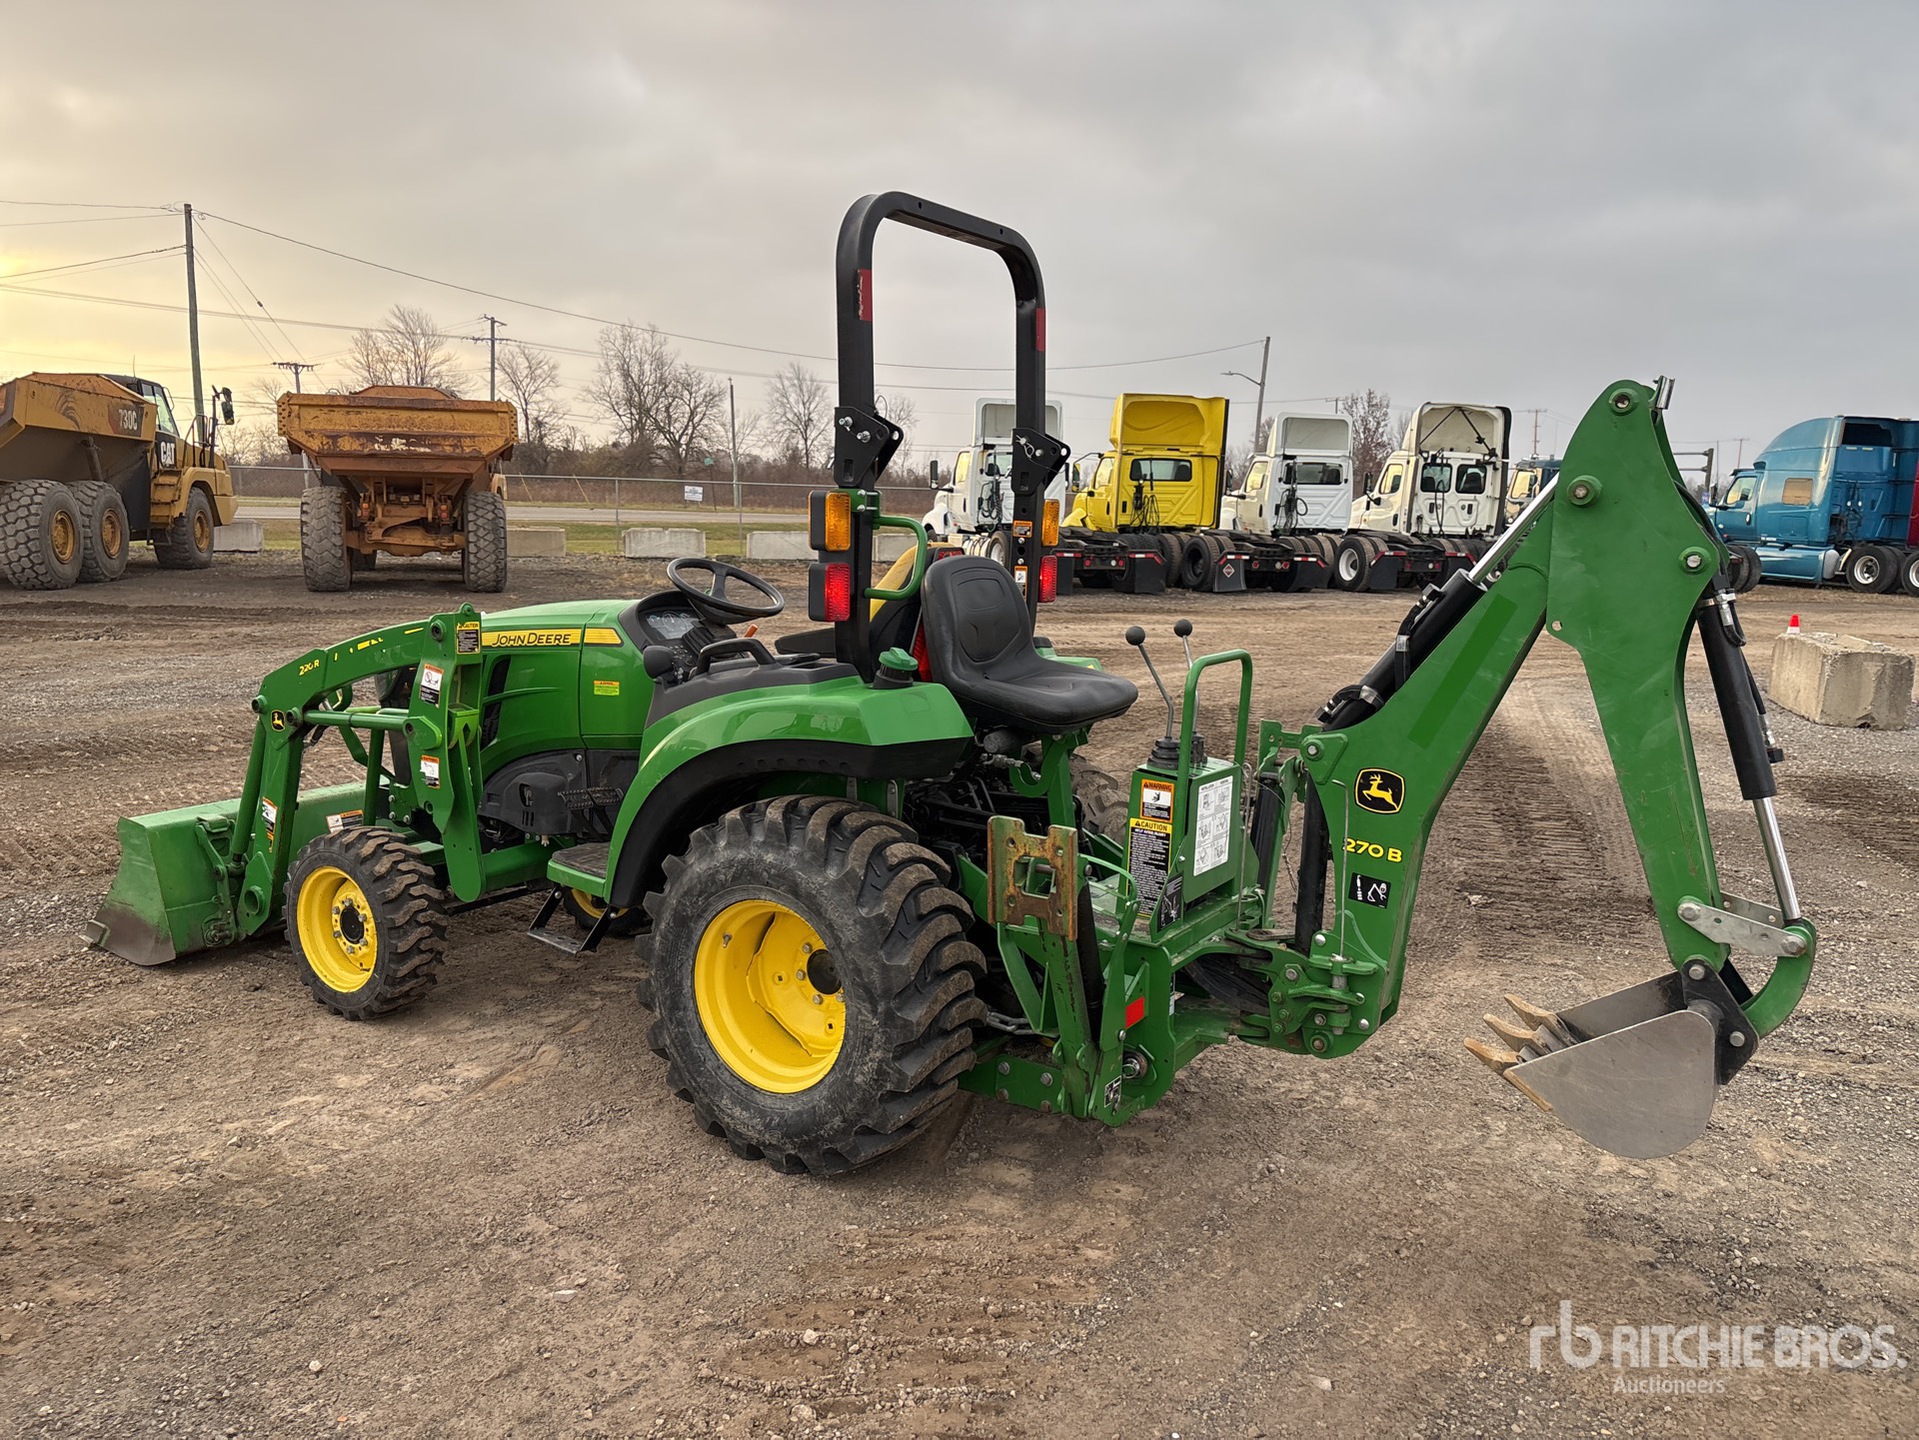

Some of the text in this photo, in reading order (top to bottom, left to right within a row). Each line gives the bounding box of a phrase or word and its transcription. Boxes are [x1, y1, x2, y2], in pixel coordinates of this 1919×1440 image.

[118, 408, 138, 431] 730C
[160, 441, 175, 466] CAT
[492, 633, 525, 646] JOHN
[526, 632, 572, 645] DEERE
[1150, 782, 1172, 791] WARNING
[1140, 821, 1168, 831] CAUTION
[1342, 837, 1402, 863] 270 B
